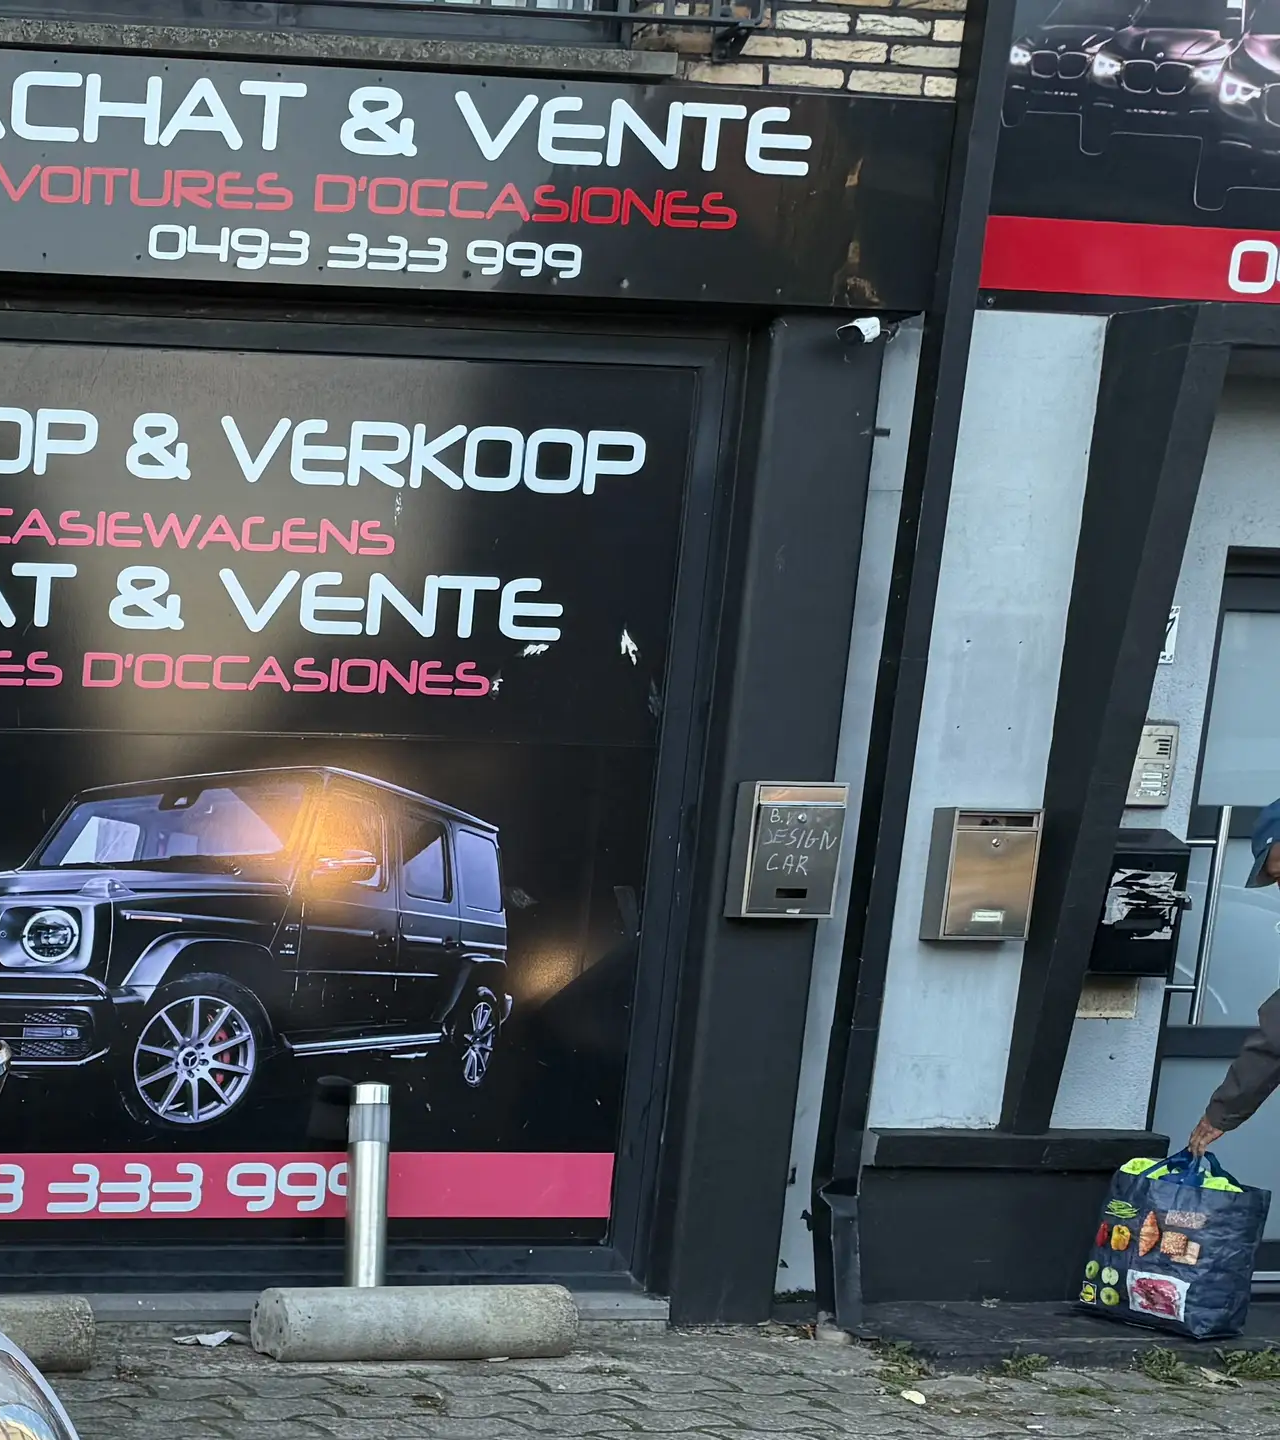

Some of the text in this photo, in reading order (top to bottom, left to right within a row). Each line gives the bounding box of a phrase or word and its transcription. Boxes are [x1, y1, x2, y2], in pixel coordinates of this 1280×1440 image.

[339, 86, 417, 158] &
[455, 90, 811, 176] VENTE
[315, 173, 738, 230] D'OCCASIONES
[148, 224, 582, 279] 0493 333 999
[1228, 240, 1280, 294] 0
[125, 412, 191, 481] &
[220, 414, 647, 495] VERKOOP
[108, 565, 185, 632] &
[218, 567, 564, 641] VENTE
[82, 651, 490, 697] D'OCCASIONES
[766, 852, 809, 877] CAR
[46, 1162, 203, 1214] 333
